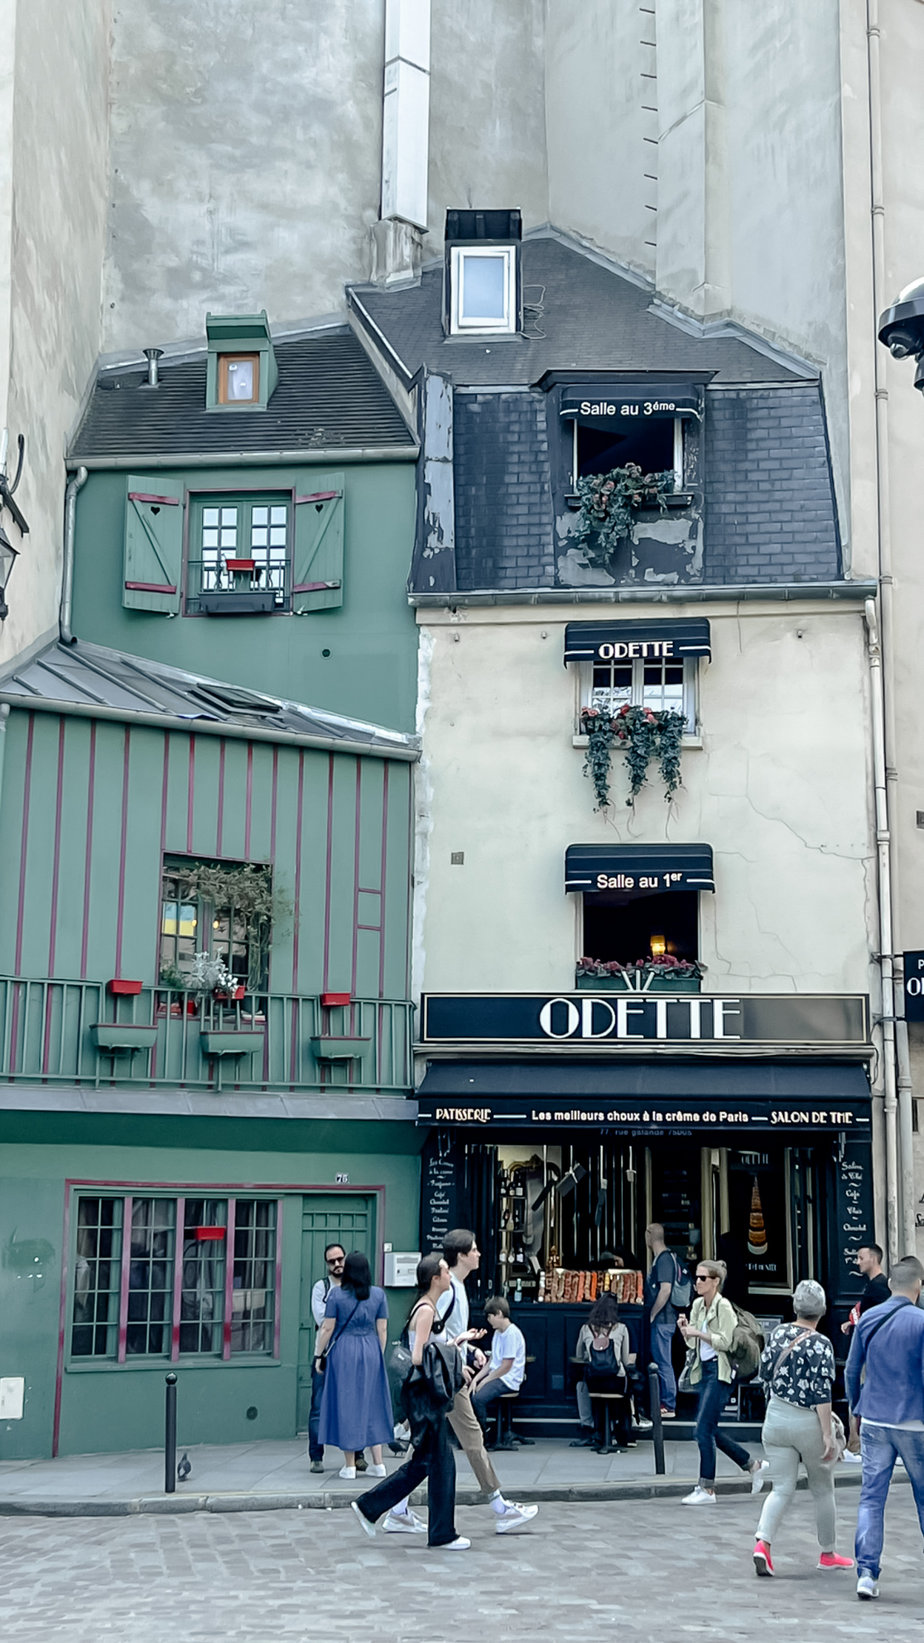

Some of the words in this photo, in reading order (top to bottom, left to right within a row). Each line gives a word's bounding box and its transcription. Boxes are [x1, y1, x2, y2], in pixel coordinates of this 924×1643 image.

[580, 401, 617, 416] Salle
[620, 404, 640, 416] au
[598, 641, 674, 660] ODETTE
[596, 874, 635, 889] Salle
[638, 877, 659, 888] au
[663, 872, 683, 888] 1er
[539, 998, 741, 1039] ODETTE
[435, 1108, 492, 1123] PATISSERIE
[531, 1110, 552, 1121] Les
[554, 1110, 605, 1121] meilleurs
[606, 1110, 641, 1121] choux
[643, 1110, 651, 1121] à
[652, 1110, 663, 1122] la
[702, 1110, 717, 1122] de
[719, 1111, 749, 1122] Paris
[770, 1111, 810, 1124] SALON
[812, 1111, 828, 1124] DE
